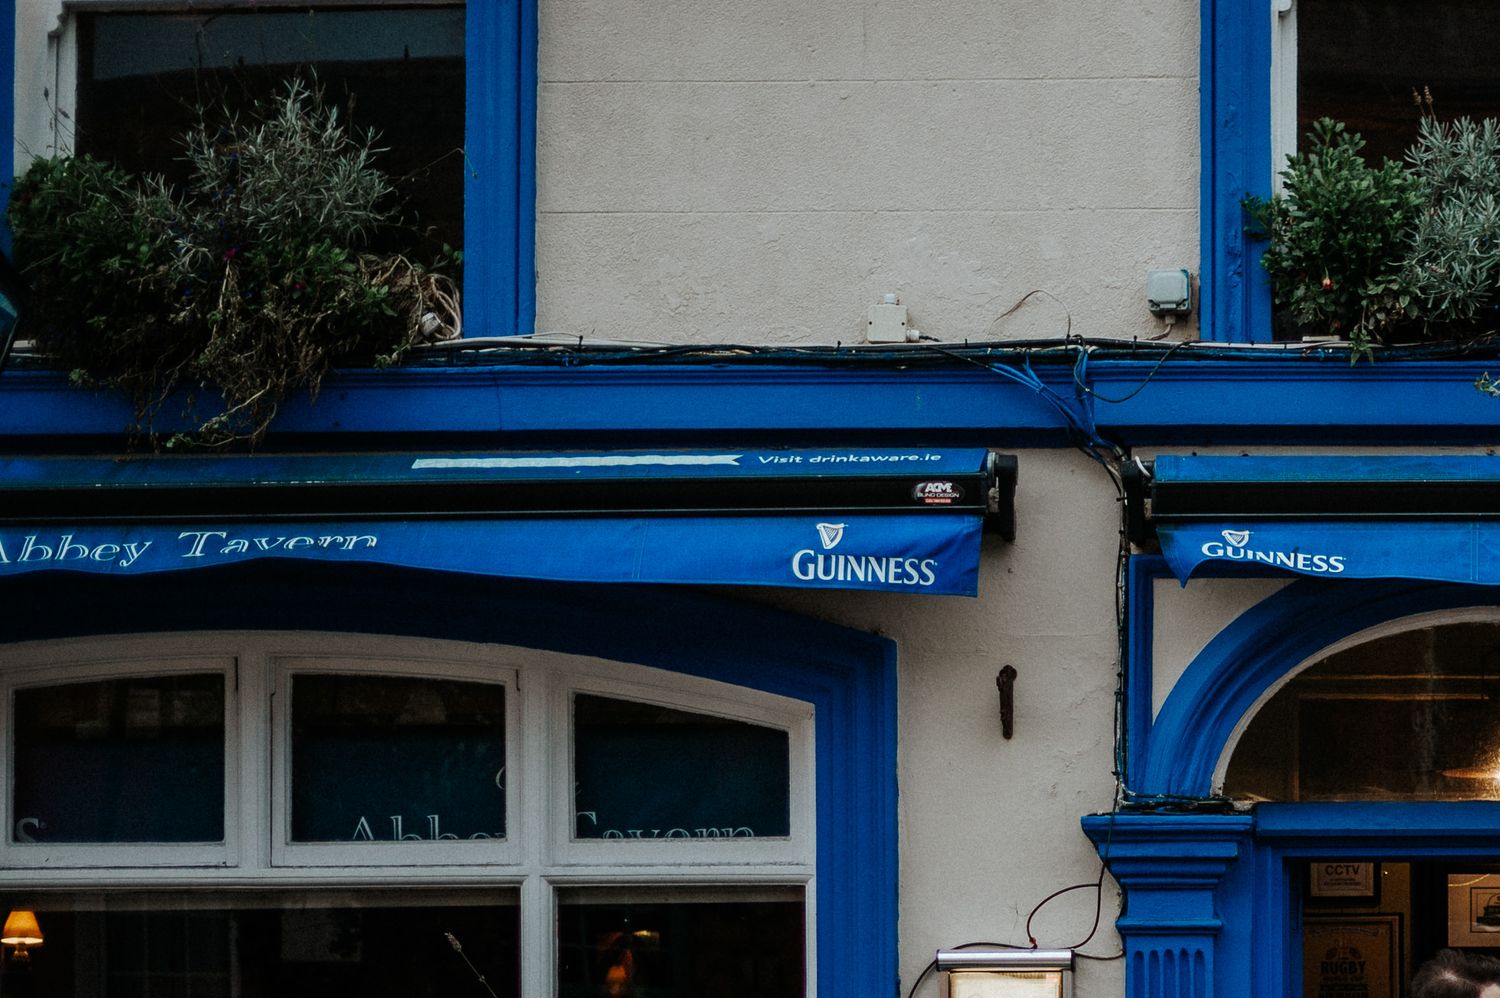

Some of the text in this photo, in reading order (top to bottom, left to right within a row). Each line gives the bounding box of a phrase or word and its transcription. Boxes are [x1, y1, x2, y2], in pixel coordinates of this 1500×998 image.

[758, 453, 942, 464] Visit drinkaware.ie
[178, 531, 379, 558] Tavern
[792, 548, 936, 586] GUINNESS
[1201, 542, 1346, 573] GUINNESS
[1324, 864, 1360, 876] CCTV
[1320, 961, 1366, 975] RUGBY
